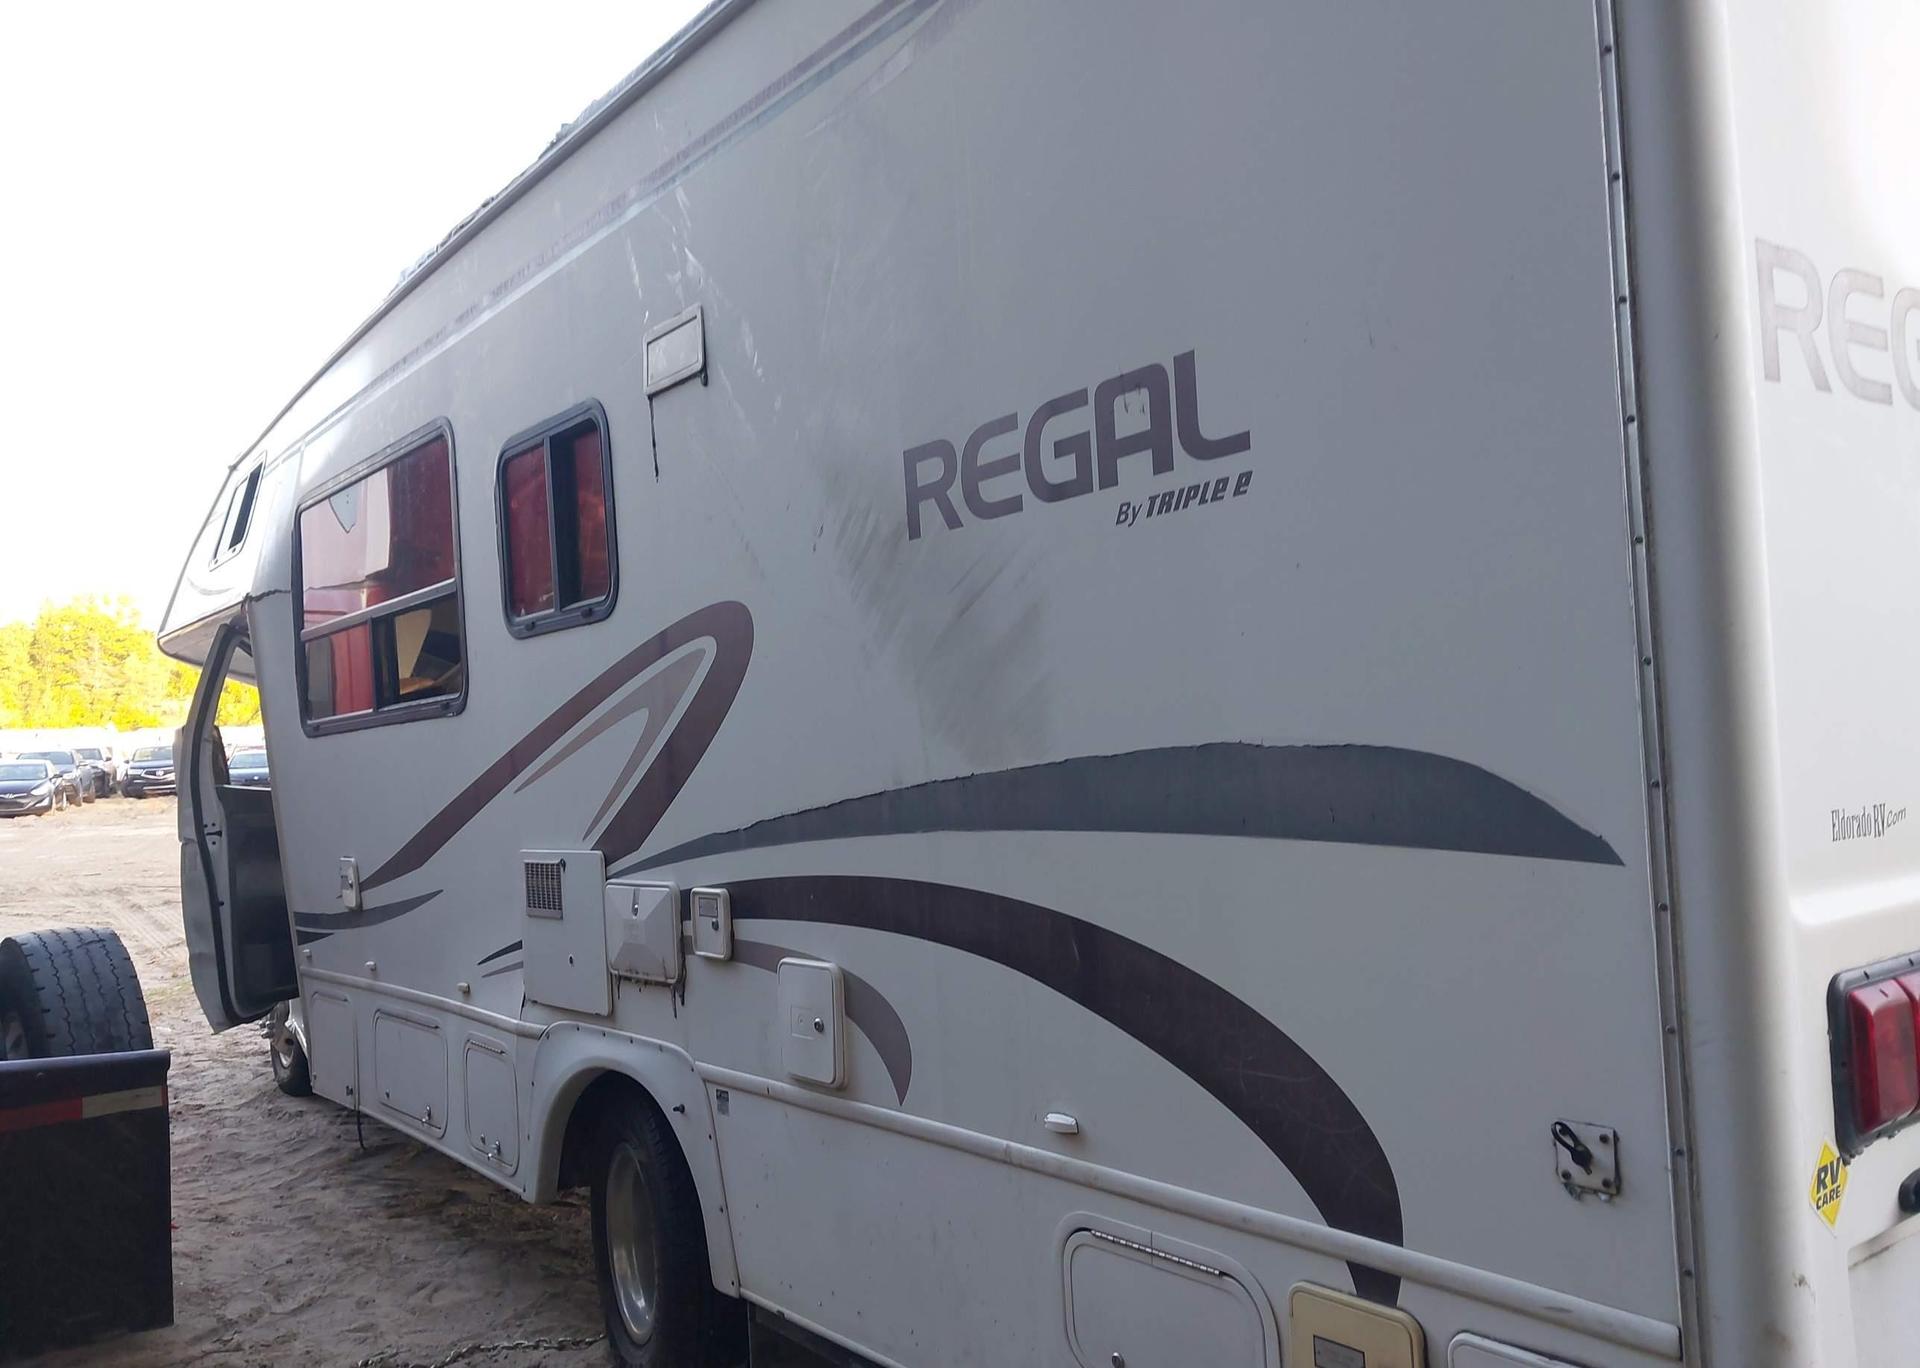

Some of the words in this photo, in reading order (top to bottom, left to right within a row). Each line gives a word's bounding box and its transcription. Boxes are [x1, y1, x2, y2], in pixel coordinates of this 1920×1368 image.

[903, 349, 1251, 541] REGAL
[1116, 501, 1142, 528] By
[1831, 805, 1872, 842] Eldorado
[1816, 1157, 1841, 1195] RV
[1816, 1184, 1841, 1210] CARE
